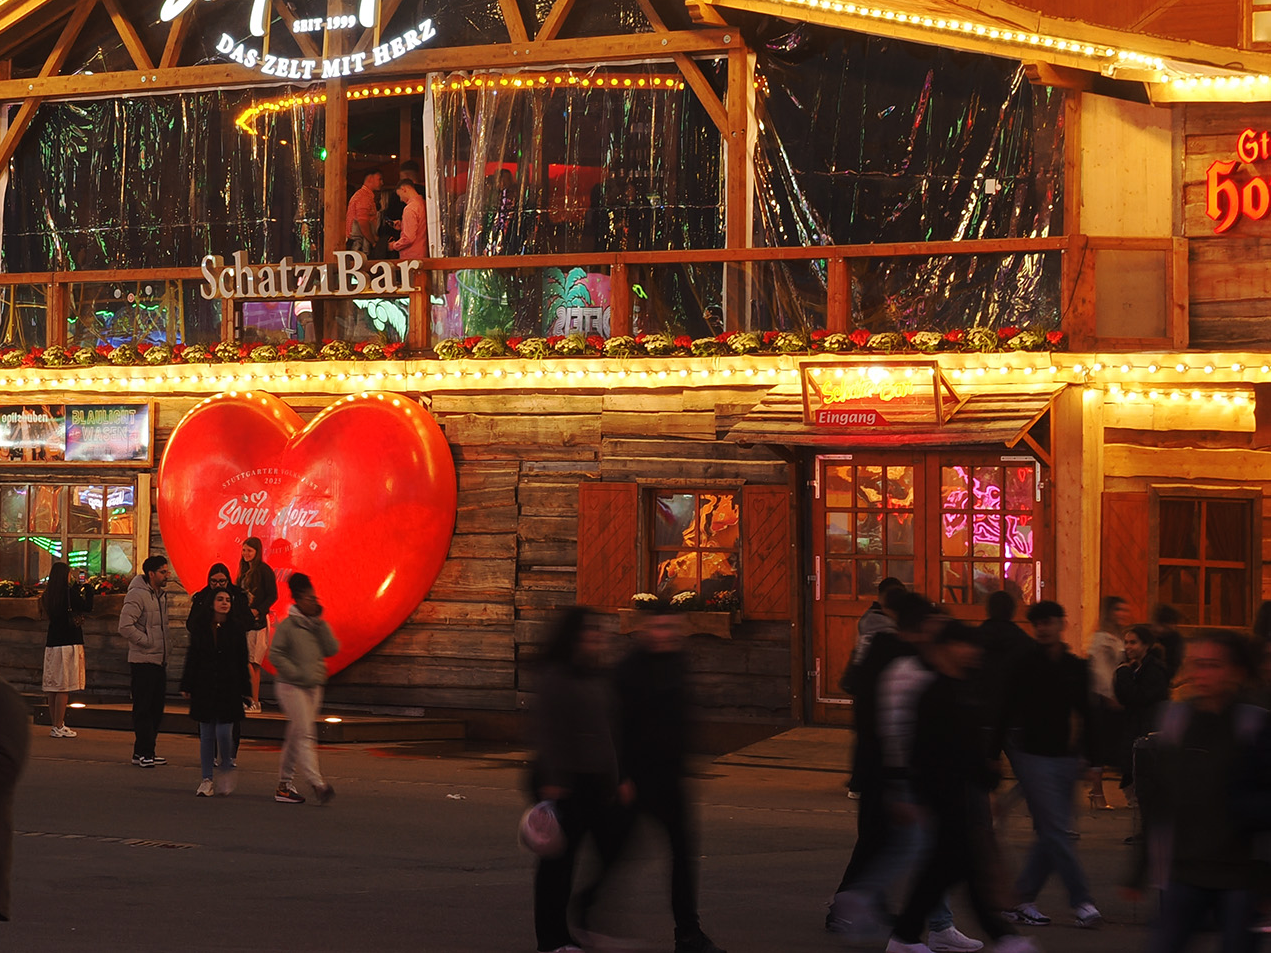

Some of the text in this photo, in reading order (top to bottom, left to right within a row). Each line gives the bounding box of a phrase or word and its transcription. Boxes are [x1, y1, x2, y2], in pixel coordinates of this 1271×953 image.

[292, 15, 356, 33] SEIT 1999
[216, 18, 437, 80] DAS ZELT MIT HERZ
[72, 409, 137, 425] BLAULICHT
[818, 411, 876, 425] Eingang
[82, 426, 128, 441] WASEN
[222, 468, 279, 489] STUTTGARTER
[264, 477, 282, 485] 2025
[217, 493, 326, 539] Sonja Merz
